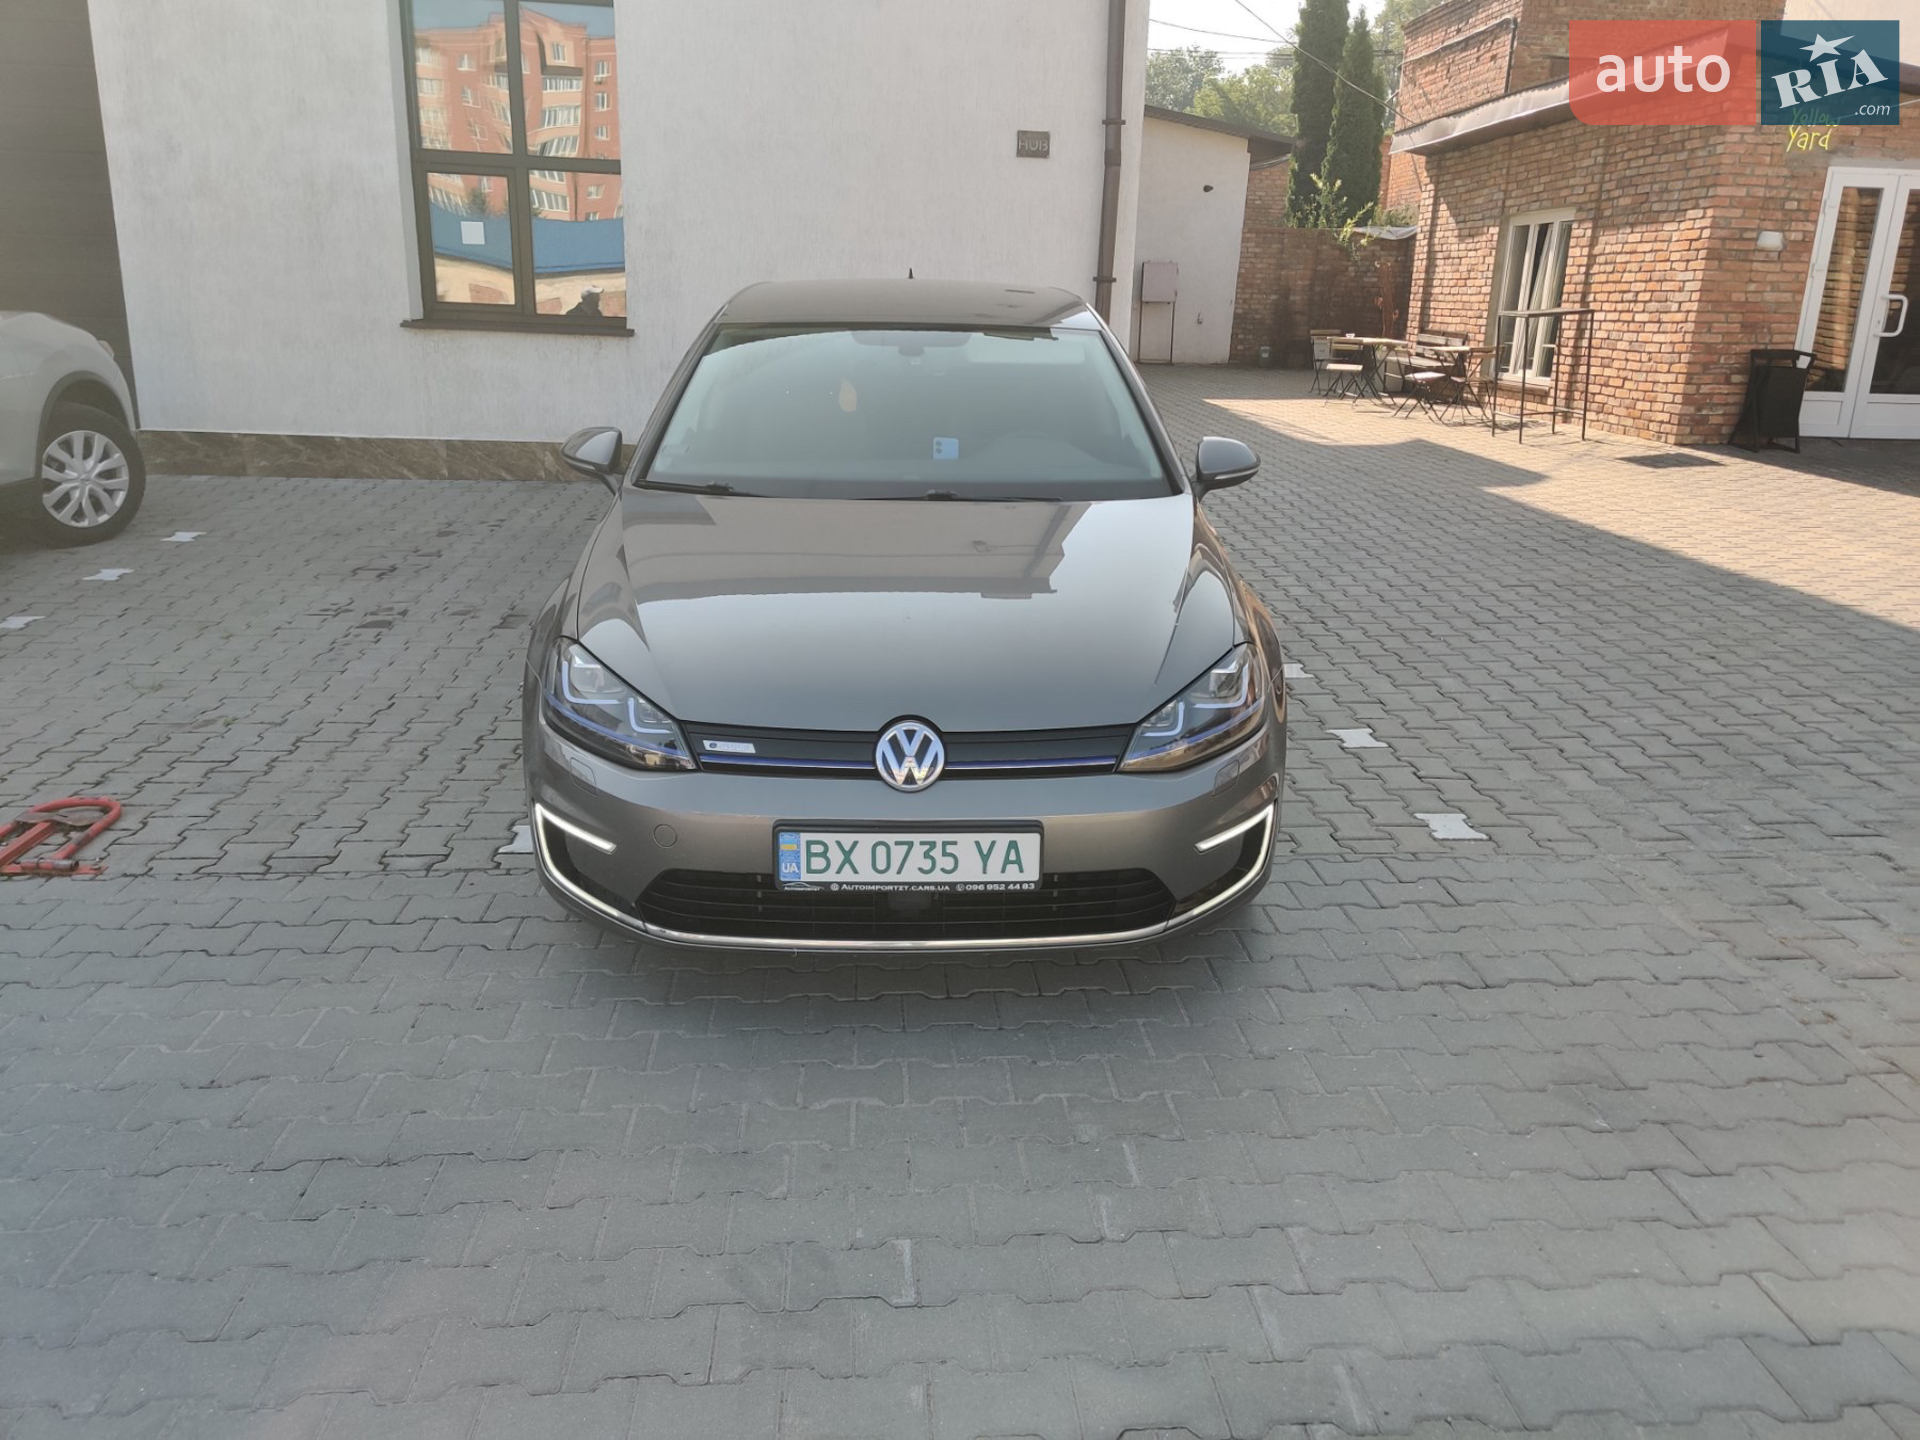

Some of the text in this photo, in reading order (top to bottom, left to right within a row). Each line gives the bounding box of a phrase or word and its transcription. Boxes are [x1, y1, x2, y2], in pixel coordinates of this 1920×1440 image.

[1786, 125, 1832, 152] Yard
[1018, 139, 1049, 151] HUB
[805, 839, 1025, 875] BX 0735 YA
[782, 862, 800, 874] UA
[965, 883, 985, 891] 096
[986, 883, 1006, 891] 952
[1007, 883, 1021, 891] 44
